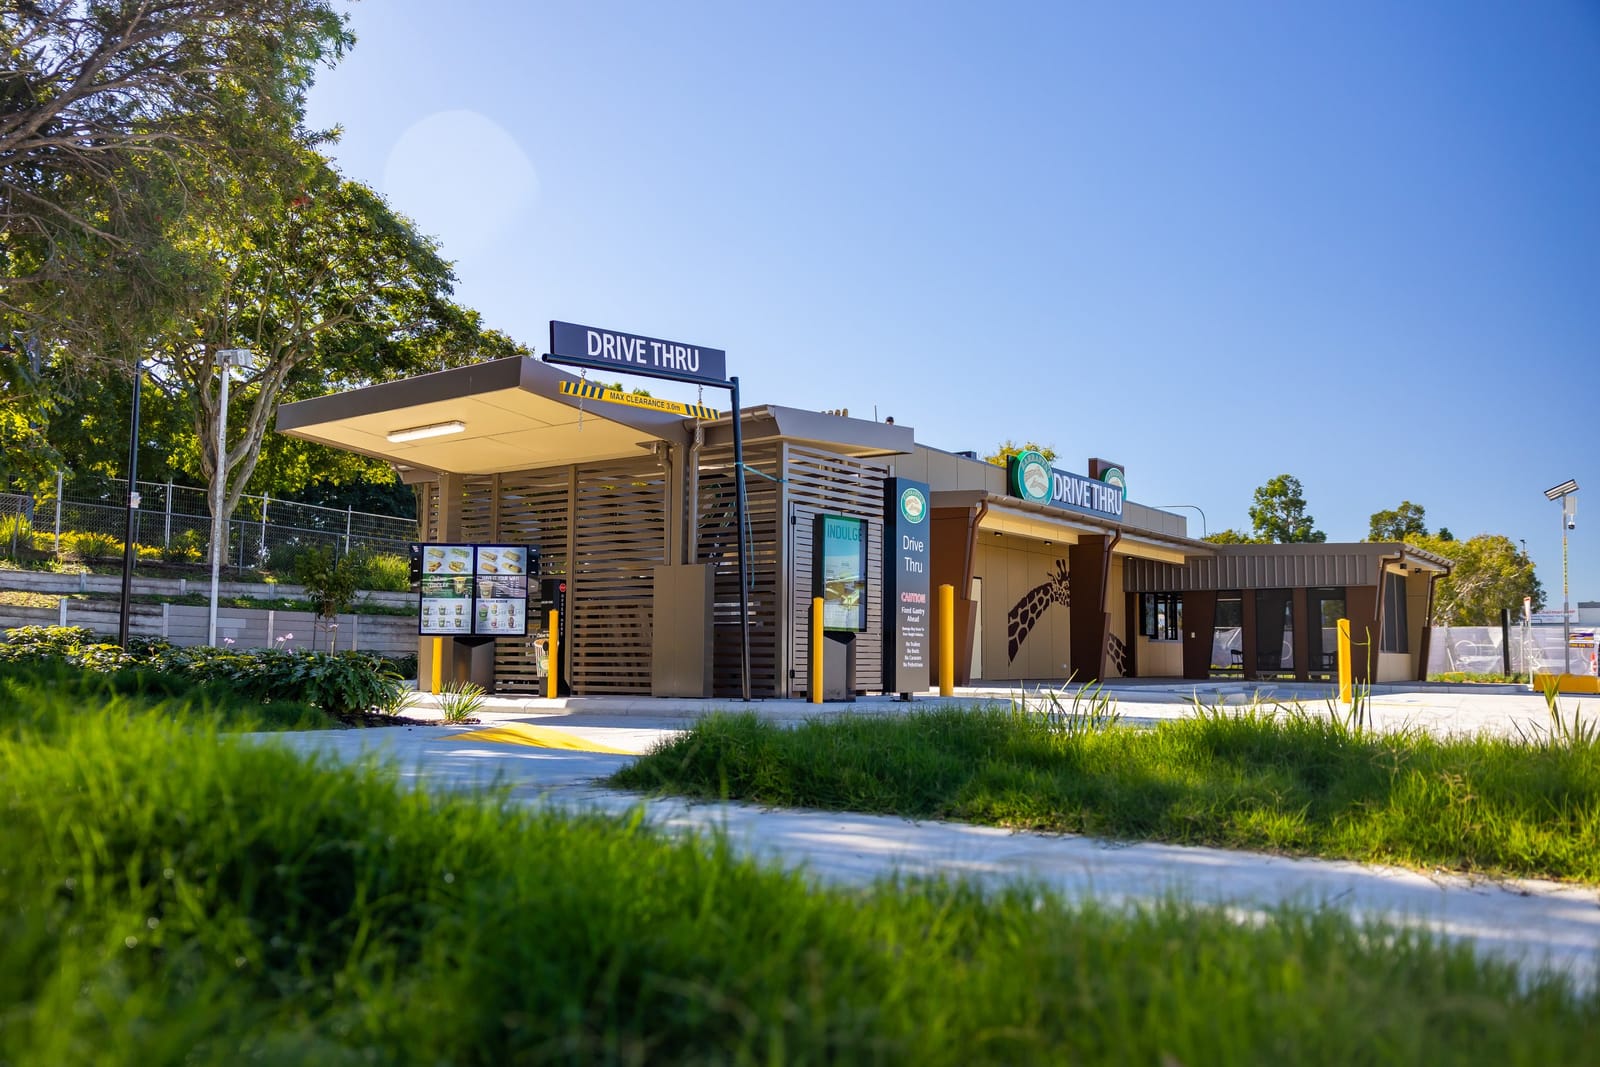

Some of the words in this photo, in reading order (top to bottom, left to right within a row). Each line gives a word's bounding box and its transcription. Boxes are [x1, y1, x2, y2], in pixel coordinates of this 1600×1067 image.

[587, 330, 647, 364] DRIVE
[650, 341, 700, 373] THRU
[609, 391, 625, 401] MAX
[626, 395, 665, 409] CLEARANCE
[666, 402, 681, 411] 3.0m
[1053, 472, 1091, 507] DRIVE
[1091, 484, 1122, 516] THRU
[827, 522, 862, 542] INDULGE
[903, 535, 924, 552] Drive
[904, 556, 923, 573] Thru
[901, 592, 926, 604] CAUTION
